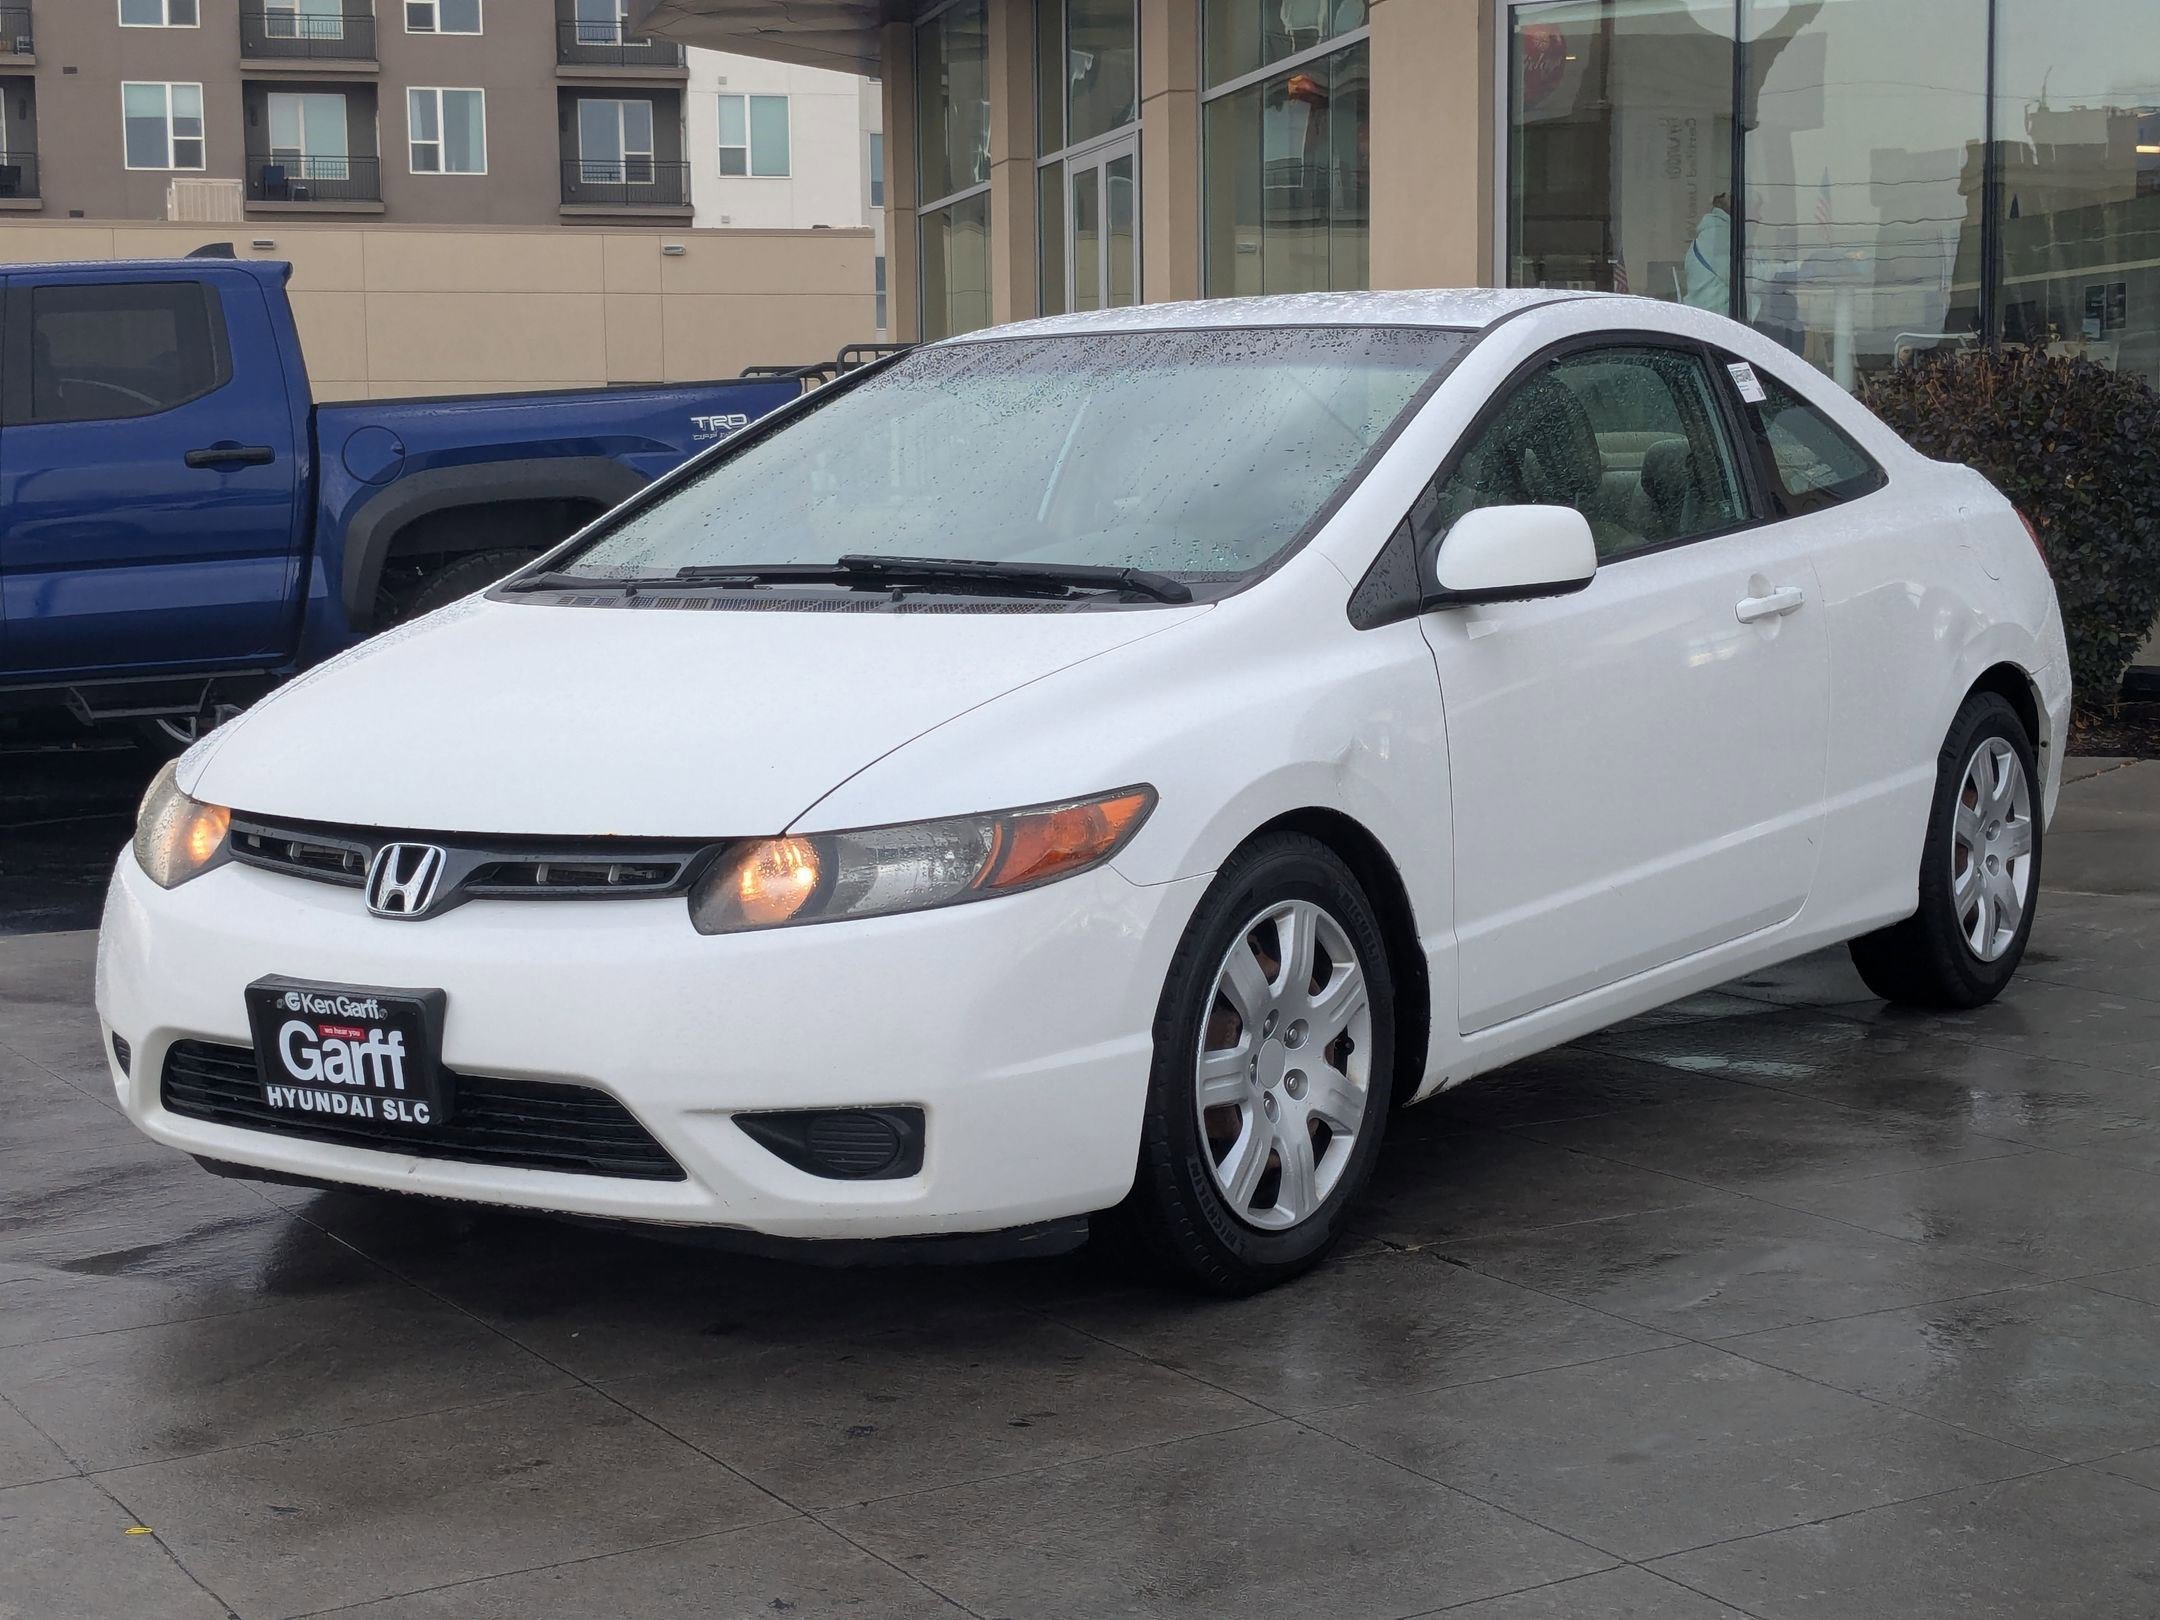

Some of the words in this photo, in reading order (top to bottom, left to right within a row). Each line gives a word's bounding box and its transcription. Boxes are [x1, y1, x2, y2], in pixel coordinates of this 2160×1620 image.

[690, 413, 748, 431] TRD
[278, 1019, 406, 1090] Garff
[266, 1085, 374, 1118] HYUNDAI
[382, 1100, 431, 1125] SLC
